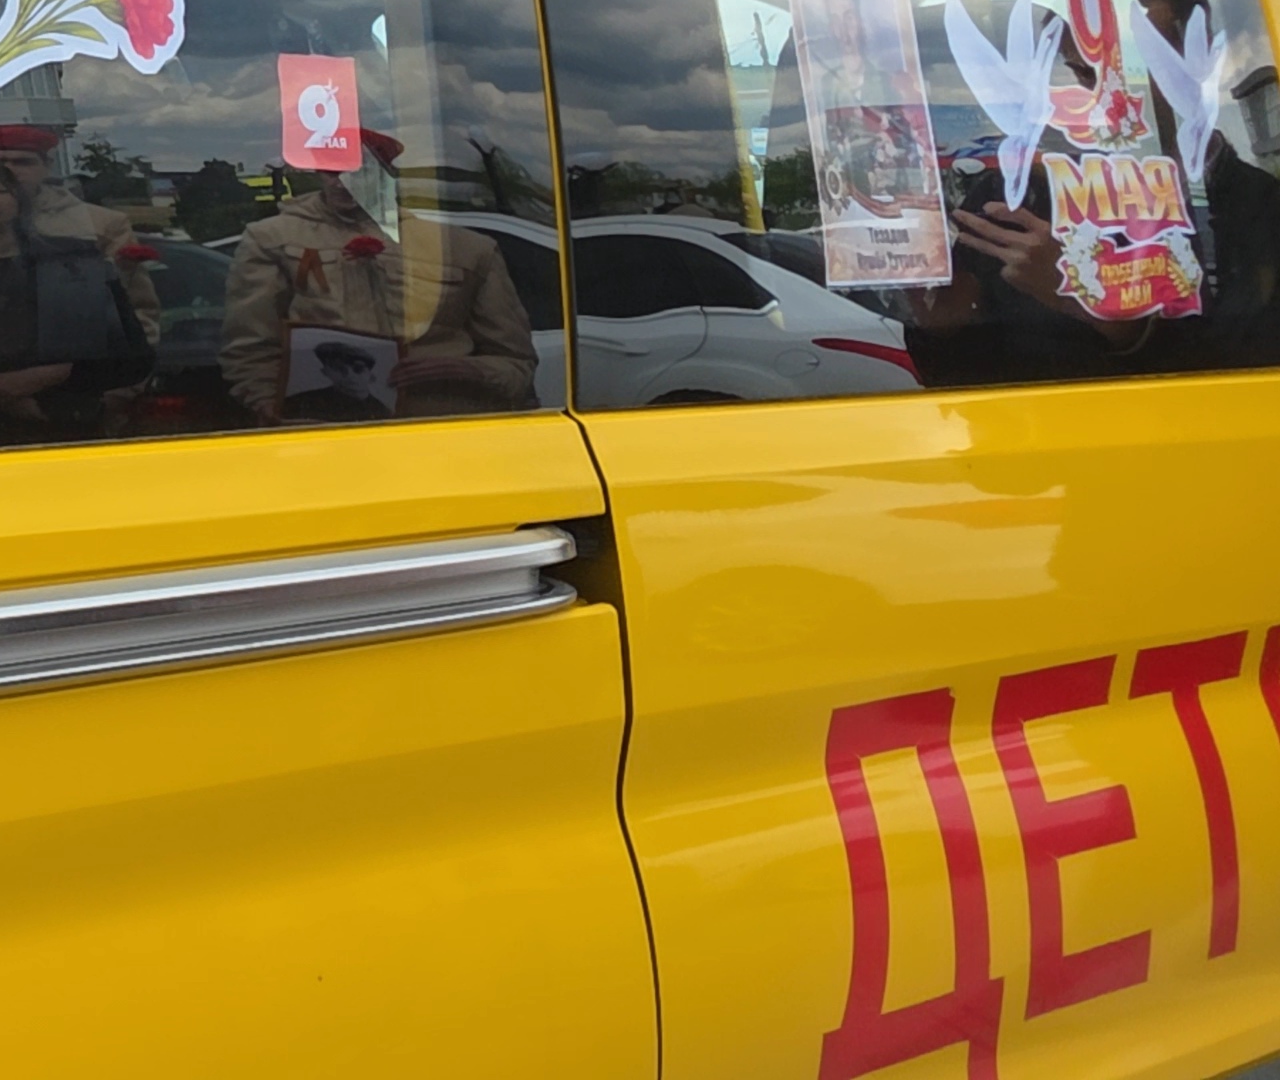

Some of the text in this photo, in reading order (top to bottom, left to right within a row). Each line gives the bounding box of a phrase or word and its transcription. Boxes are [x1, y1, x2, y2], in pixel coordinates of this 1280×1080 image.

[298, 84, 340, 148] 9
[1049, 158, 1184, 227] МАЯ
[818, 624, 1280, 1080] ДЕТ
